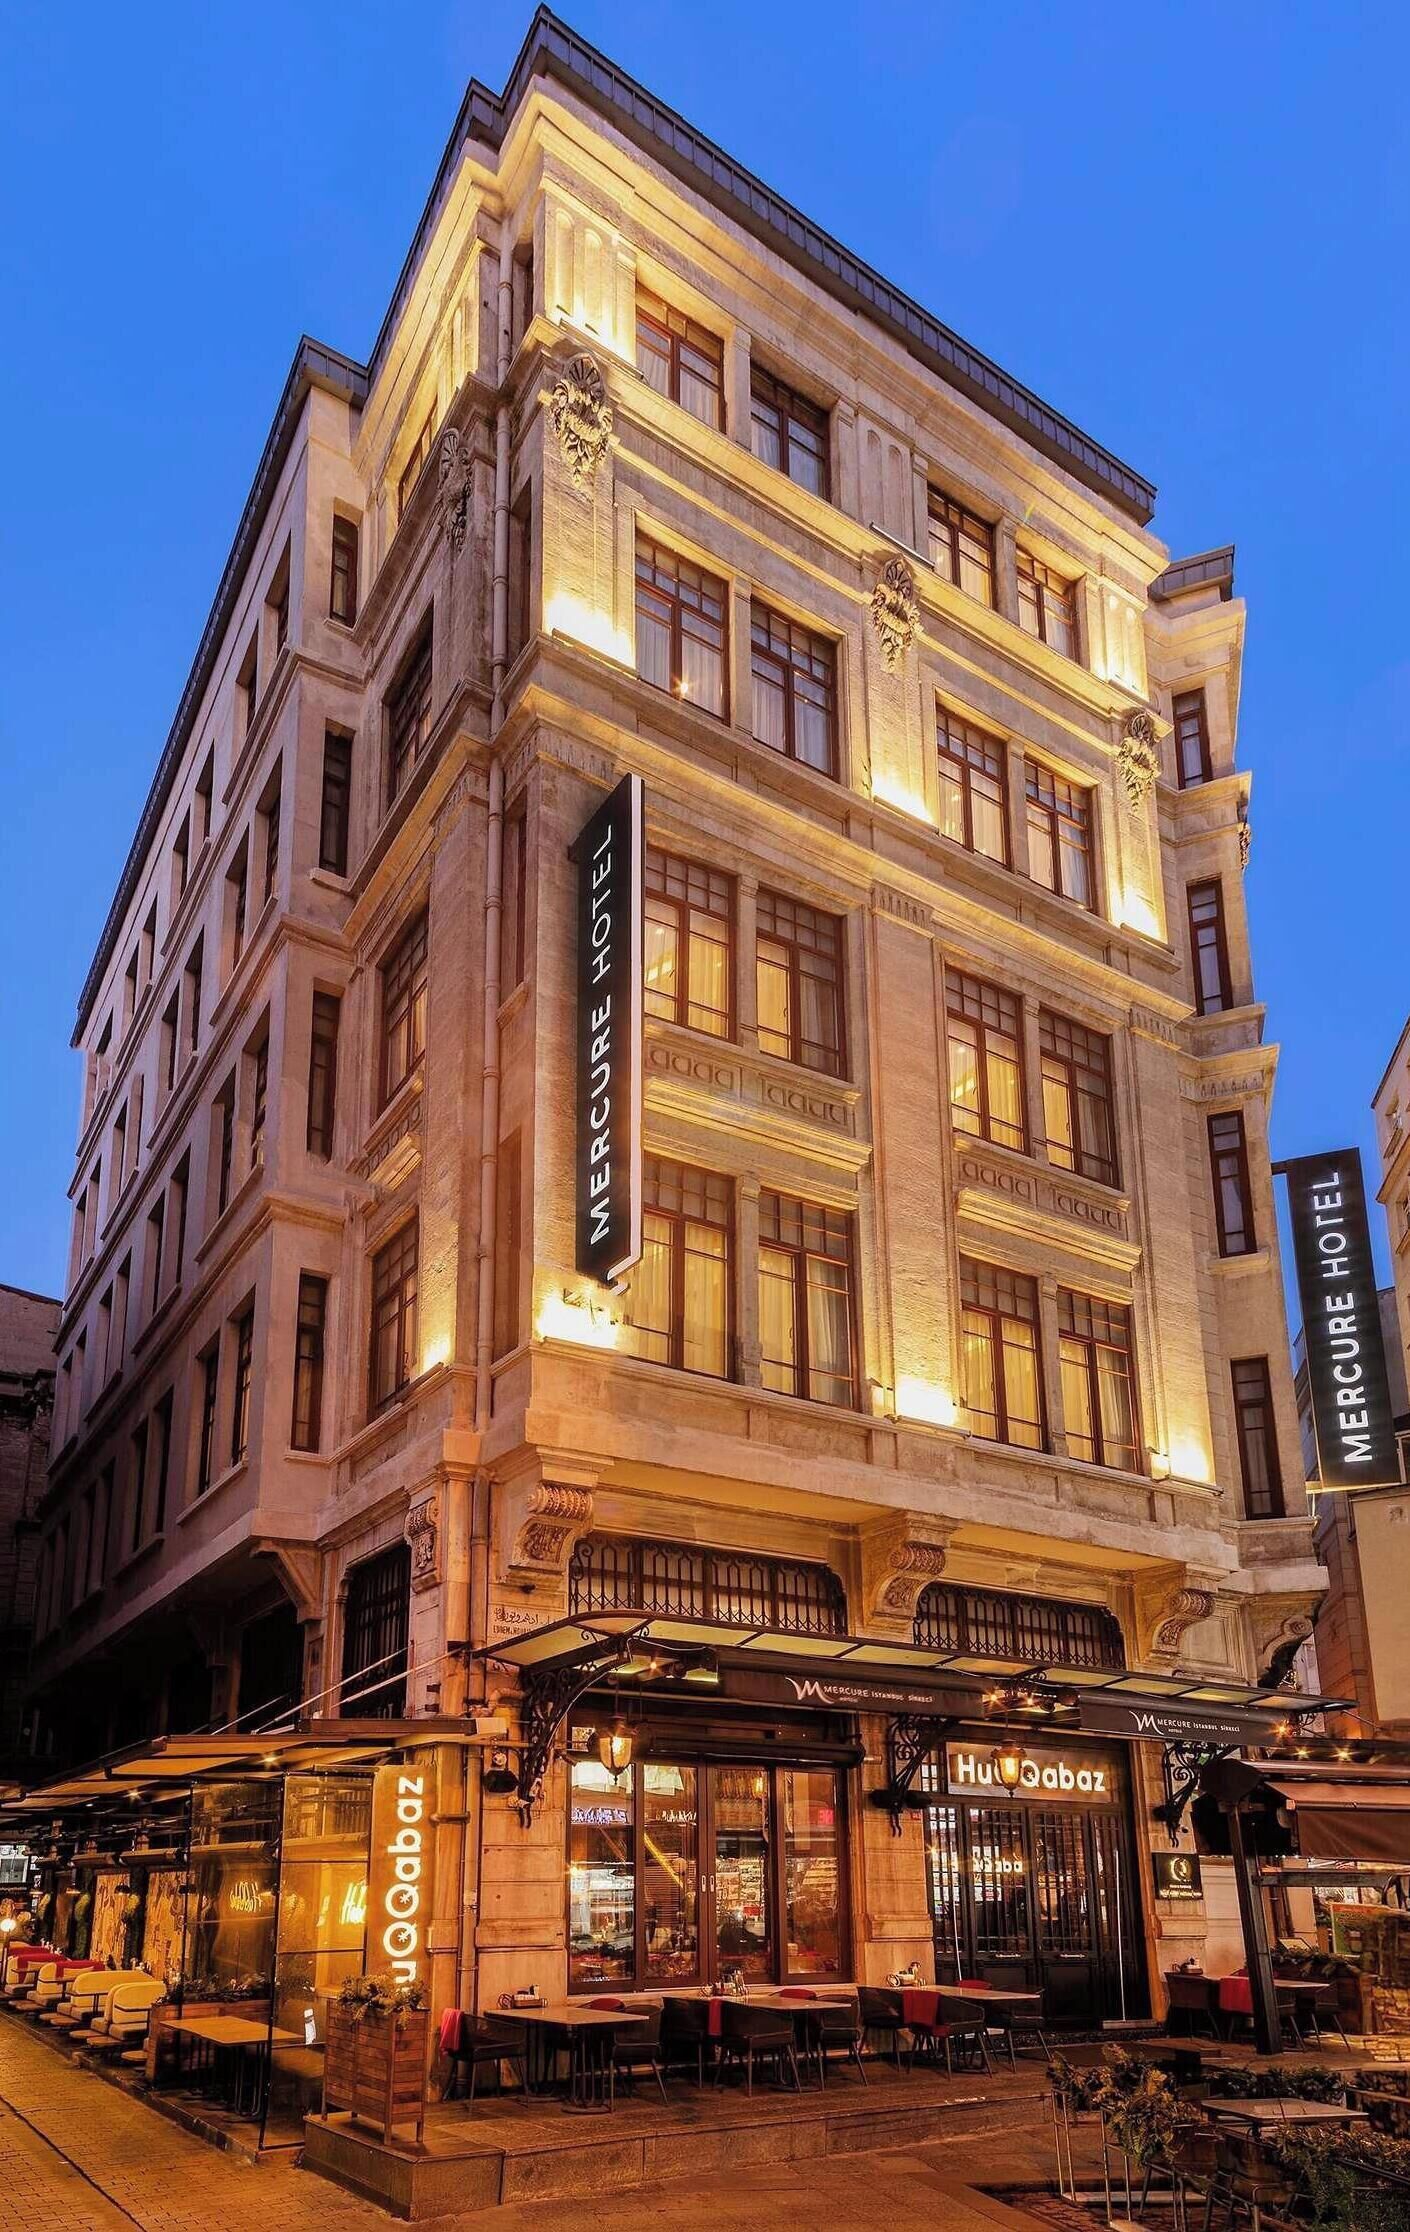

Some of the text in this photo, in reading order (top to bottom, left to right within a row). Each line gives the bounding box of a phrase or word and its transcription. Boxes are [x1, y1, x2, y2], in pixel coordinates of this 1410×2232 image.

[590, 823, 613, 1246] MERCURE HOTEL
[1312, 1171, 1373, 1464] MERCURE HOTEL
[823, 1685, 869, 1698] MERCURE
[1157, 1718, 1191, 1729] MERCURE
[957, 1753, 1106, 1792] HuQabaz
[383, 1776, 424, 1990] uQQabaz
